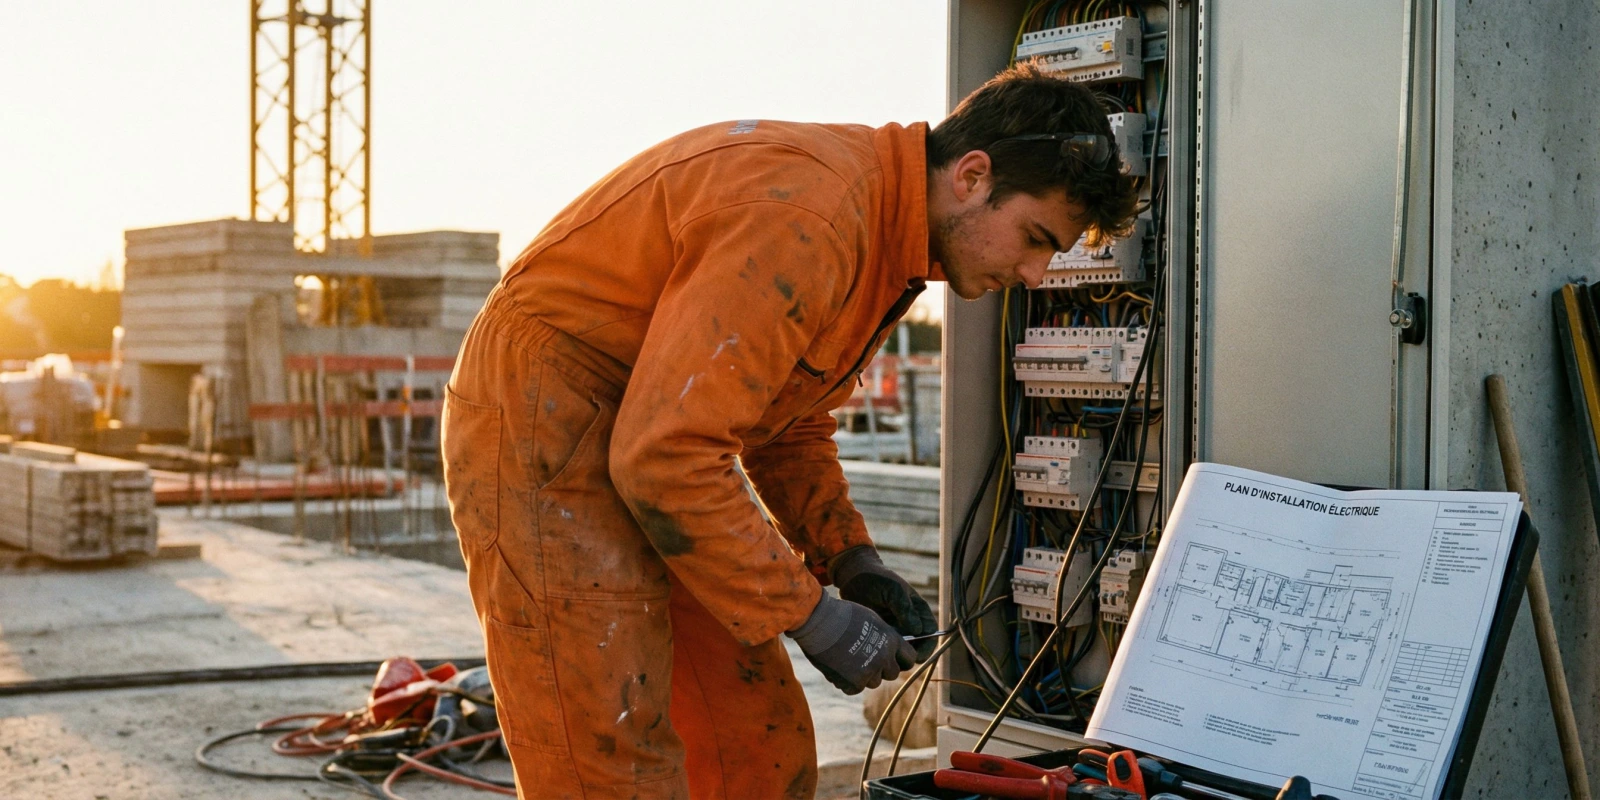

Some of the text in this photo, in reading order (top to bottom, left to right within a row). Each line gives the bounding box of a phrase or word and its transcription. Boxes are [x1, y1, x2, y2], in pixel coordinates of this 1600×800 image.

[1224, 482, 1380, 516] PLAN D'INSTALLATION ÉLECTRIQUE
